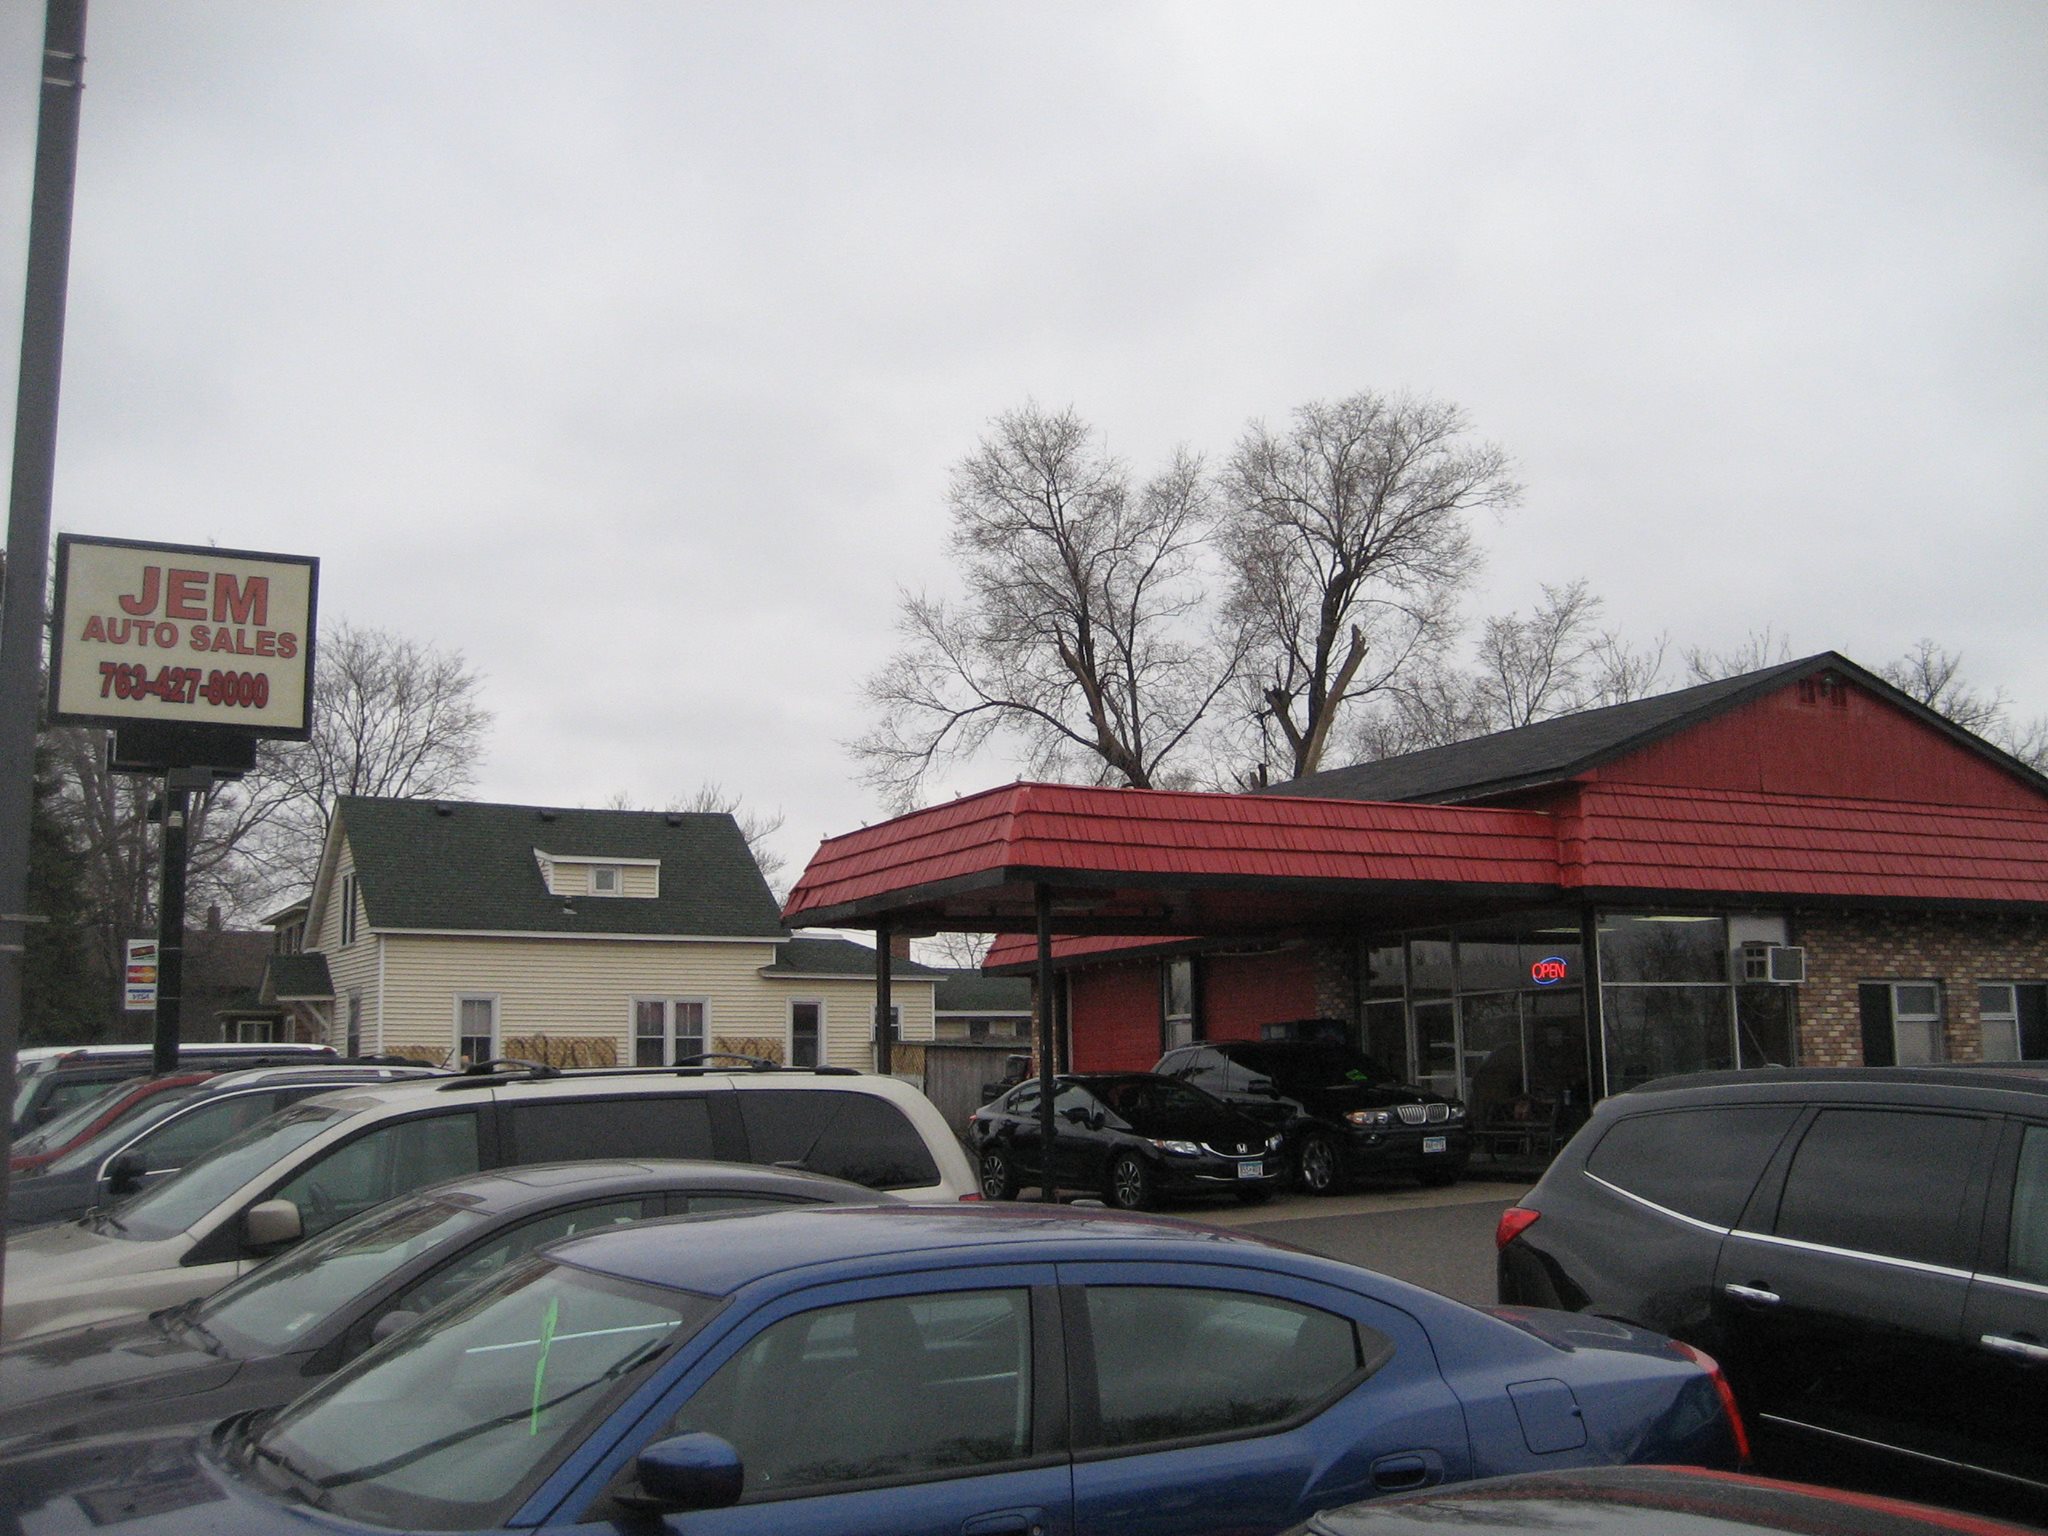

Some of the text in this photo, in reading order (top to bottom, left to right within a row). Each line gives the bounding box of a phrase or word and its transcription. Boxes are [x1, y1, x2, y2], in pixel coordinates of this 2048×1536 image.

[119, 566, 268, 626] JEM
[81, 615, 298, 658] AUTO SALES
[1532, 962, 1565, 979] OPEN
